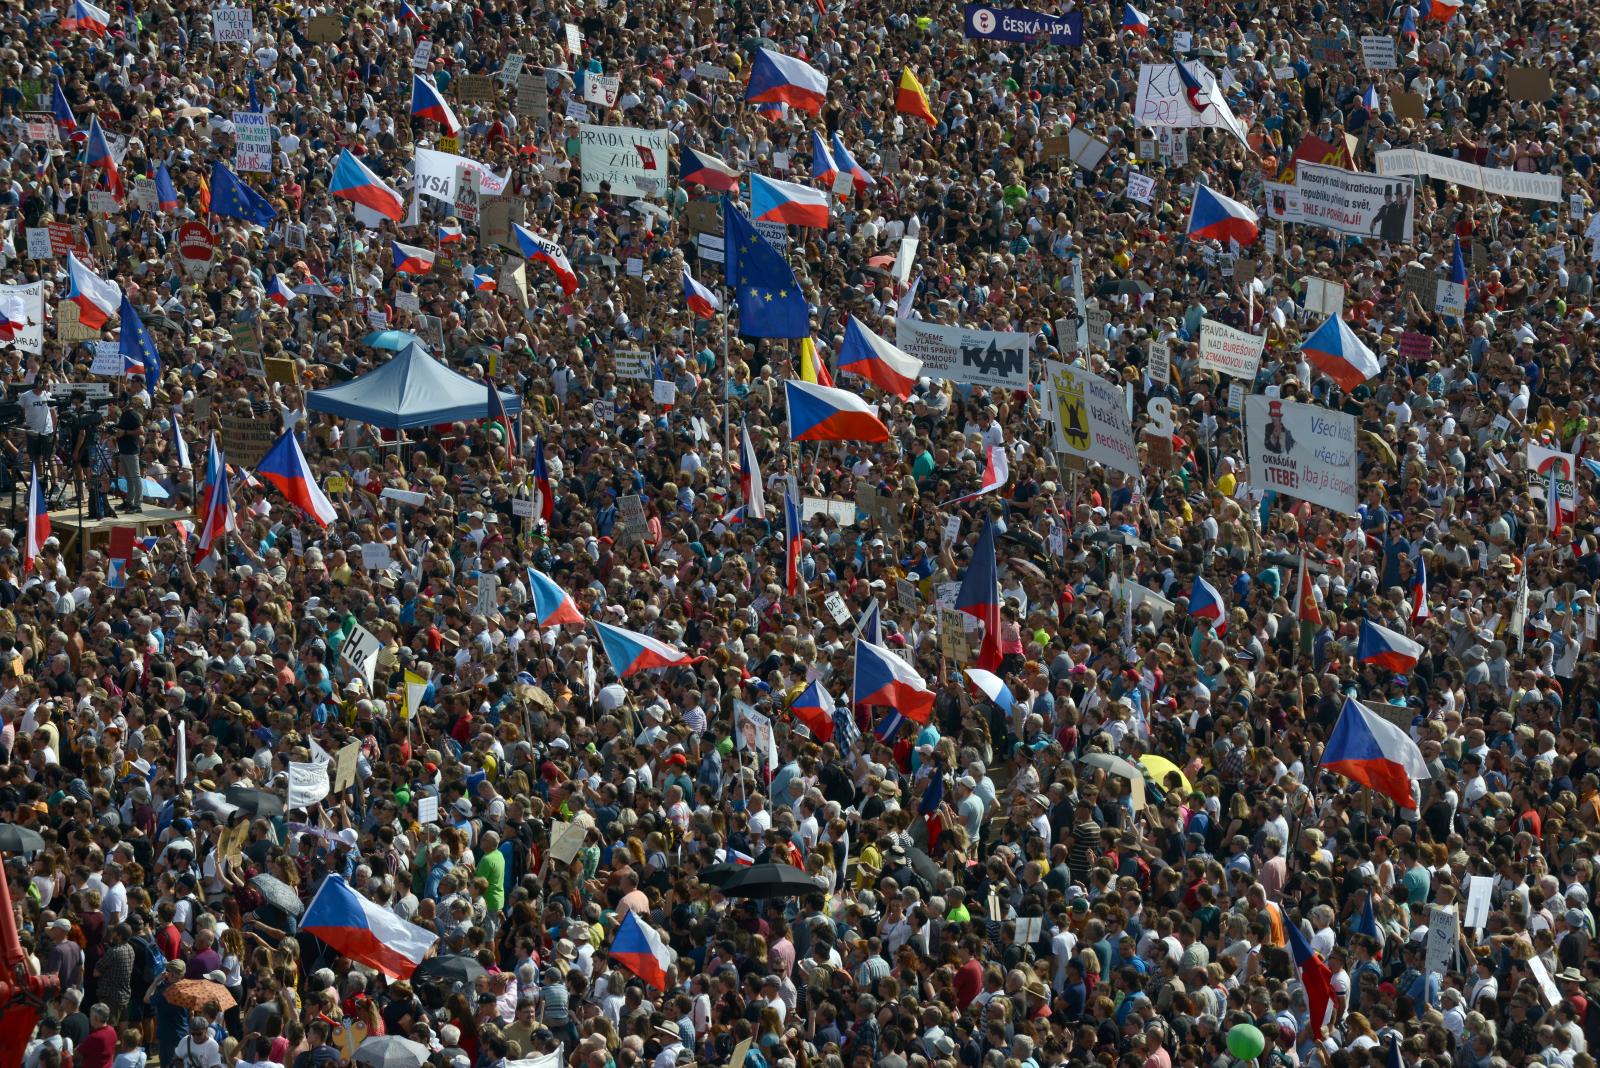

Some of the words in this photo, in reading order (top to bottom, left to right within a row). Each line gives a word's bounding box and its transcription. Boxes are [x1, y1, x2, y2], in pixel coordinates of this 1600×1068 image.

[229, 21, 244, 29] TEN
[1003, 16, 1040, 34] ČESKÁ
[1045, 21, 1072, 36] LÍPA
[1141, 99, 1178, 125] PRO
[580, 130, 624, 147] PRAVDA
[1301, 171, 1329, 186] Masaryk
[1300, 188, 1330, 202] republiku
[1352, 198, 1371, 212] svět,
[538, 240, 562, 258] NEPO
[1200, 324, 1228, 338] PRAVDA
[904, 344, 929, 353] STÁTNÍ
[930, 346, 957, 355] SPRÁVU
[1207, 339, 1221, 349] NAD
[960, 338, 1024, 378] KAN
[1205, 351, 1243, 369] ZEMANOVOU
[1311, 415, 1337, 437] Všeci
[1314, 447, 1339, 466] všeci
[1269, 466, 1300, 489] TEBE!
[1303, 465, 1318, 485] iba
[1319, 468, 1329, 490] já
